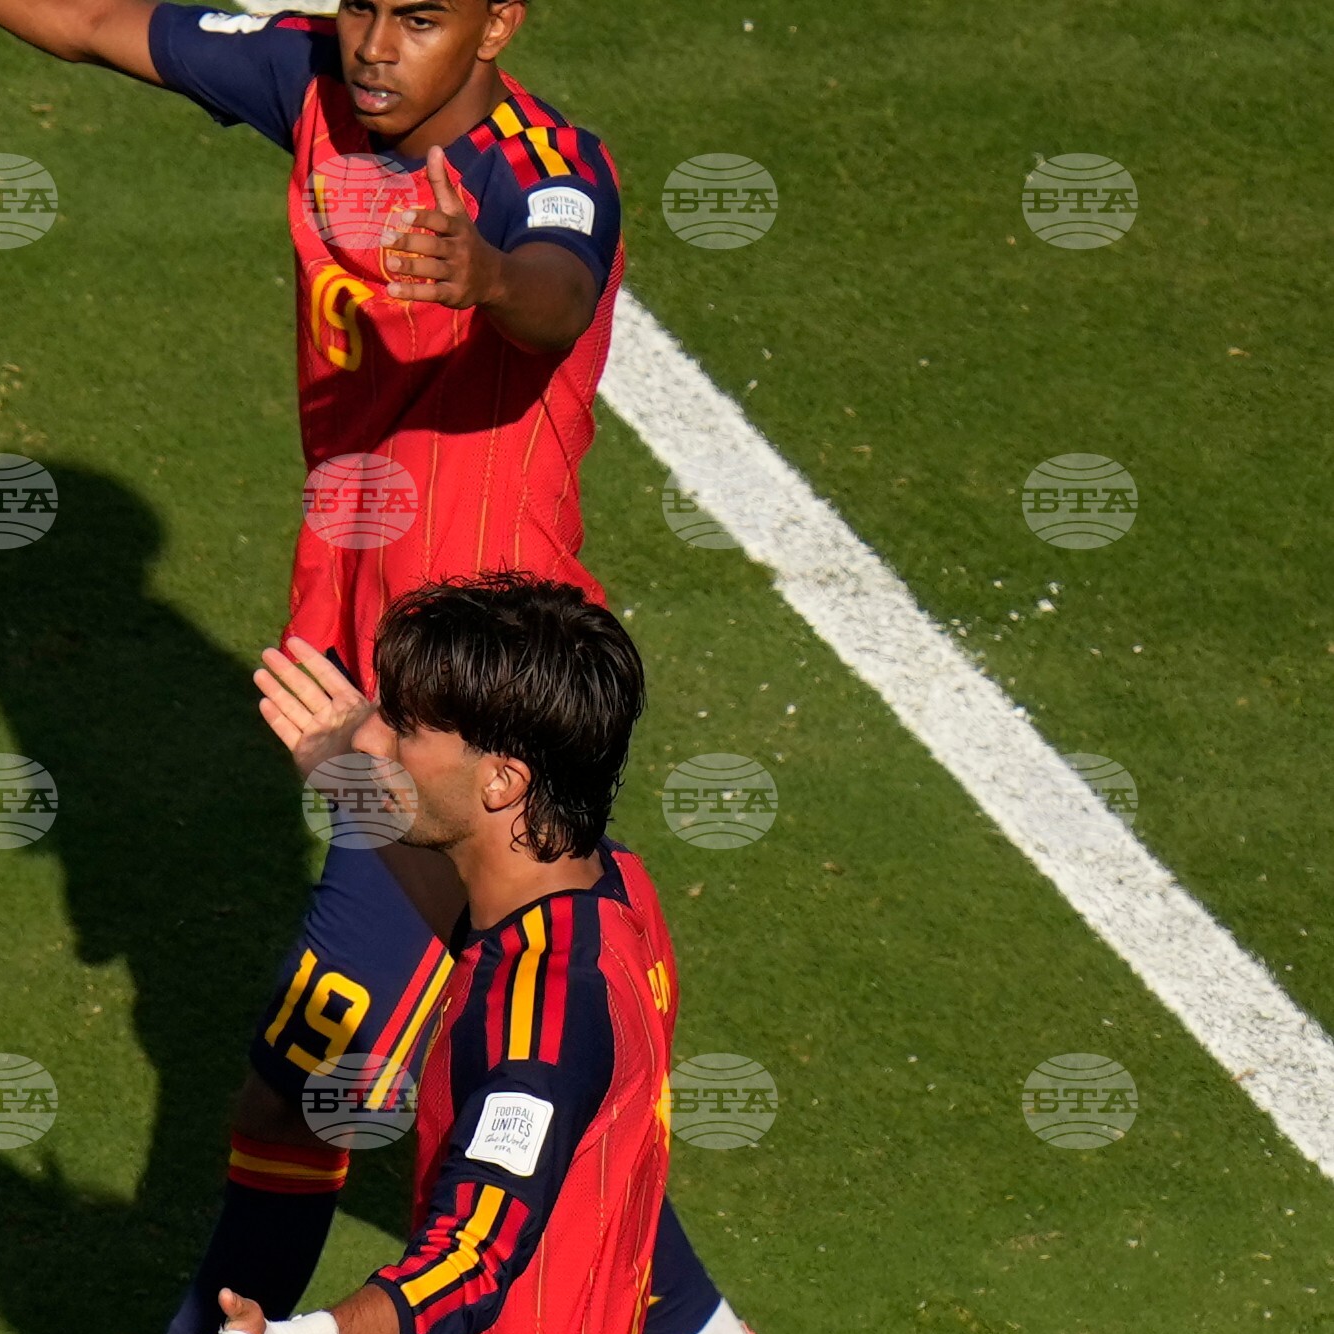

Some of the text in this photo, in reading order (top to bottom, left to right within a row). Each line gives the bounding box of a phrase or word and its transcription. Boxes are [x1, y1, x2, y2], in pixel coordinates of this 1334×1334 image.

[265, 948, 371, 1077] 19
[495, 1106, 535, 1124] FOOTBALL
[491, 1118, 533, 1138] UNITES
